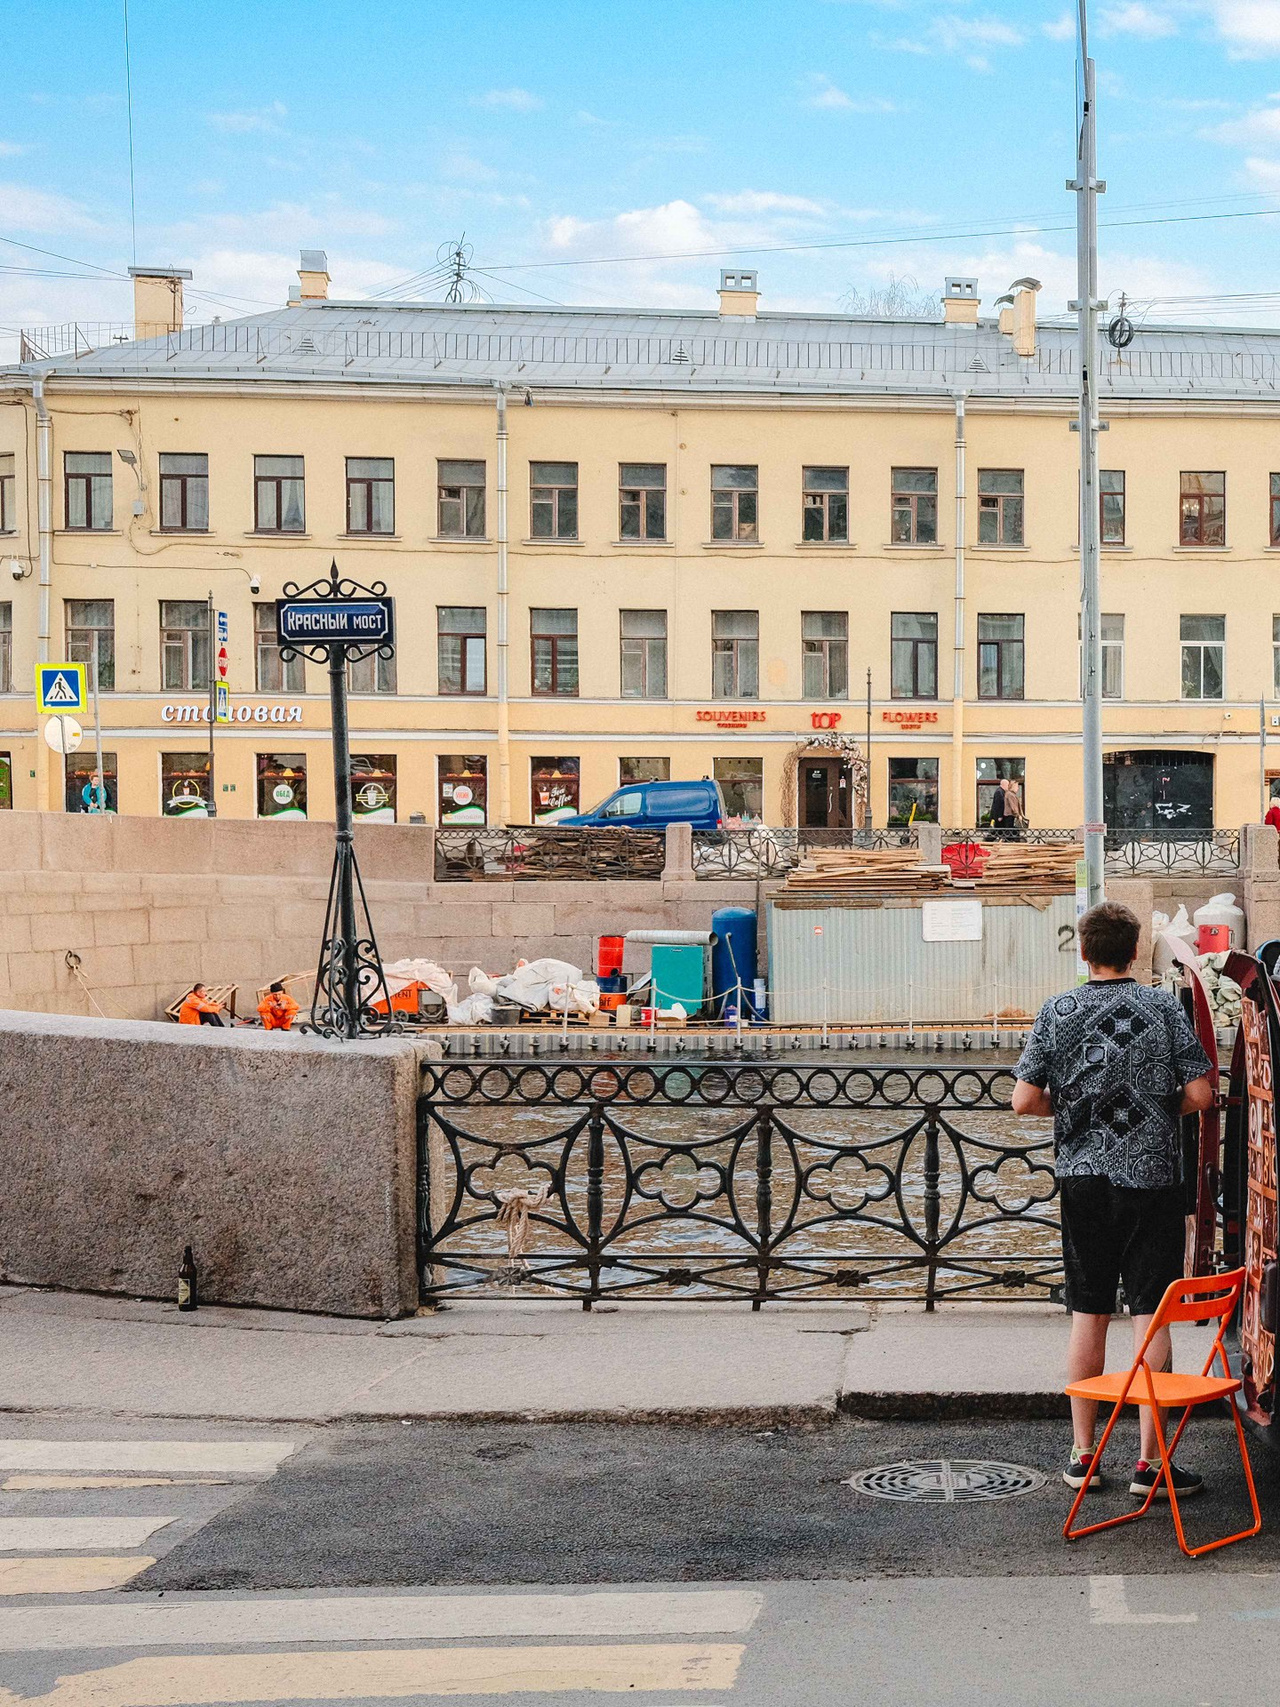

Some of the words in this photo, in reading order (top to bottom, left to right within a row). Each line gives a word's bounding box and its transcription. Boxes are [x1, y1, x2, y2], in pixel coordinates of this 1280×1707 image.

[161, 704, 303, 722] стоовая
[696, 711, 766, 721] SOUVENIRS
[882, 712, 938, 723] FLOWERS
